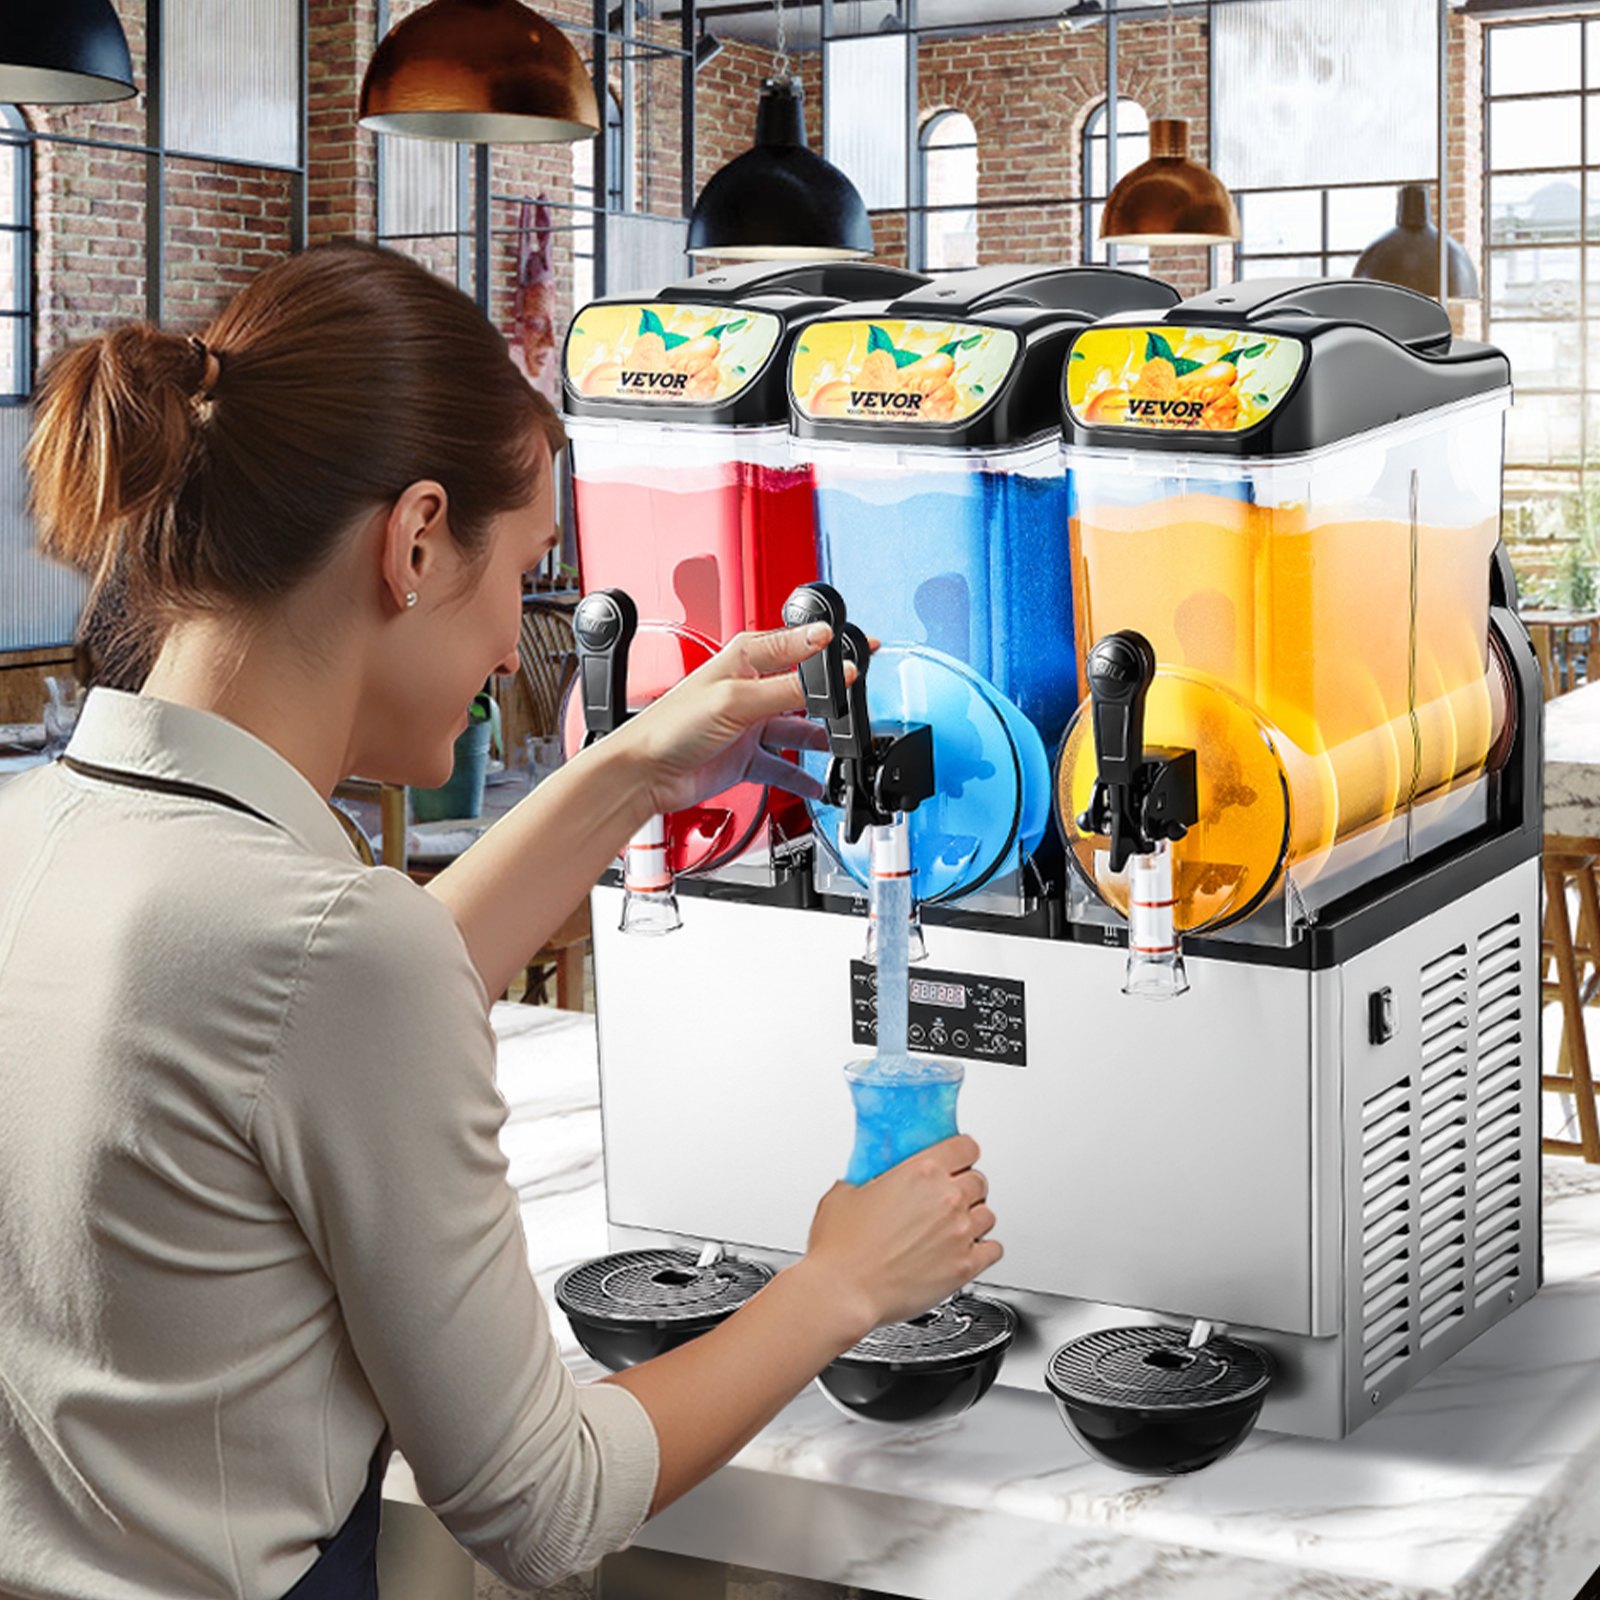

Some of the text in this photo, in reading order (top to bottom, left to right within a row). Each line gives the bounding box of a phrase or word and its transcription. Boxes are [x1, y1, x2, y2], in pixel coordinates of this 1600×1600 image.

[621, 371, 688, 389] VEVOR
[850, 391, 923, 409] VEVOR
[1128, 399, 1204, 418] VEVOR
